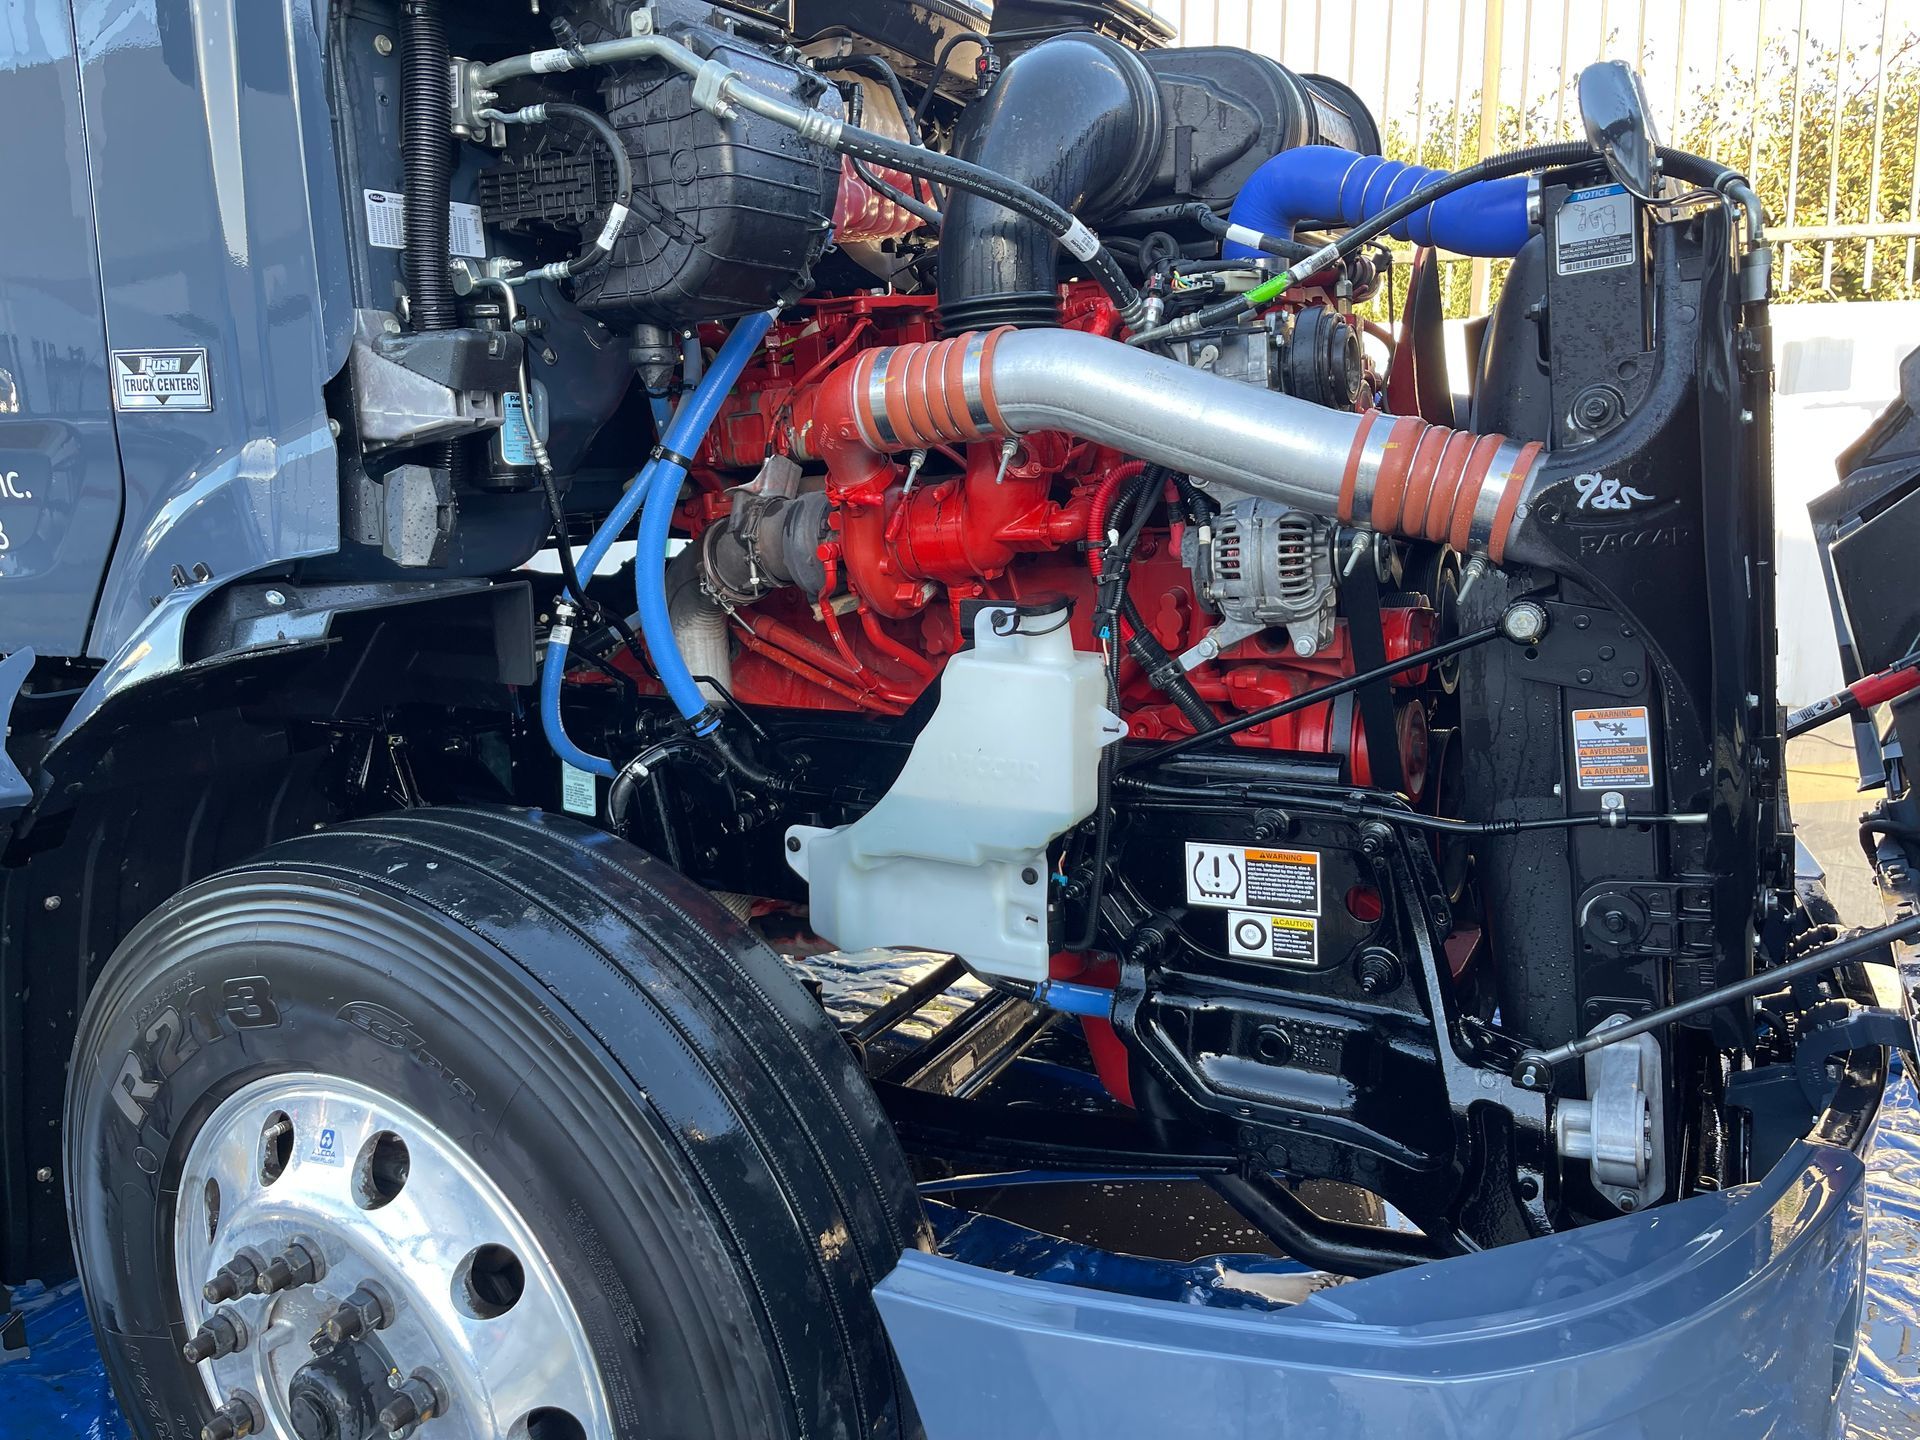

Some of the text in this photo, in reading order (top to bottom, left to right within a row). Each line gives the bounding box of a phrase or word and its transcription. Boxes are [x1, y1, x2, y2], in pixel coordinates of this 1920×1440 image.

[1577, 188, 1610, 200] NOTICE
[139, 357, 180, 378] RUSH
[125, 377, 198, 392] TRUCK CENTERS
[1265, 853, 1302, 861] WARNING
[1279, 920, 1313, 928] CAUTION
[110, 975, 282, 1131] R213
